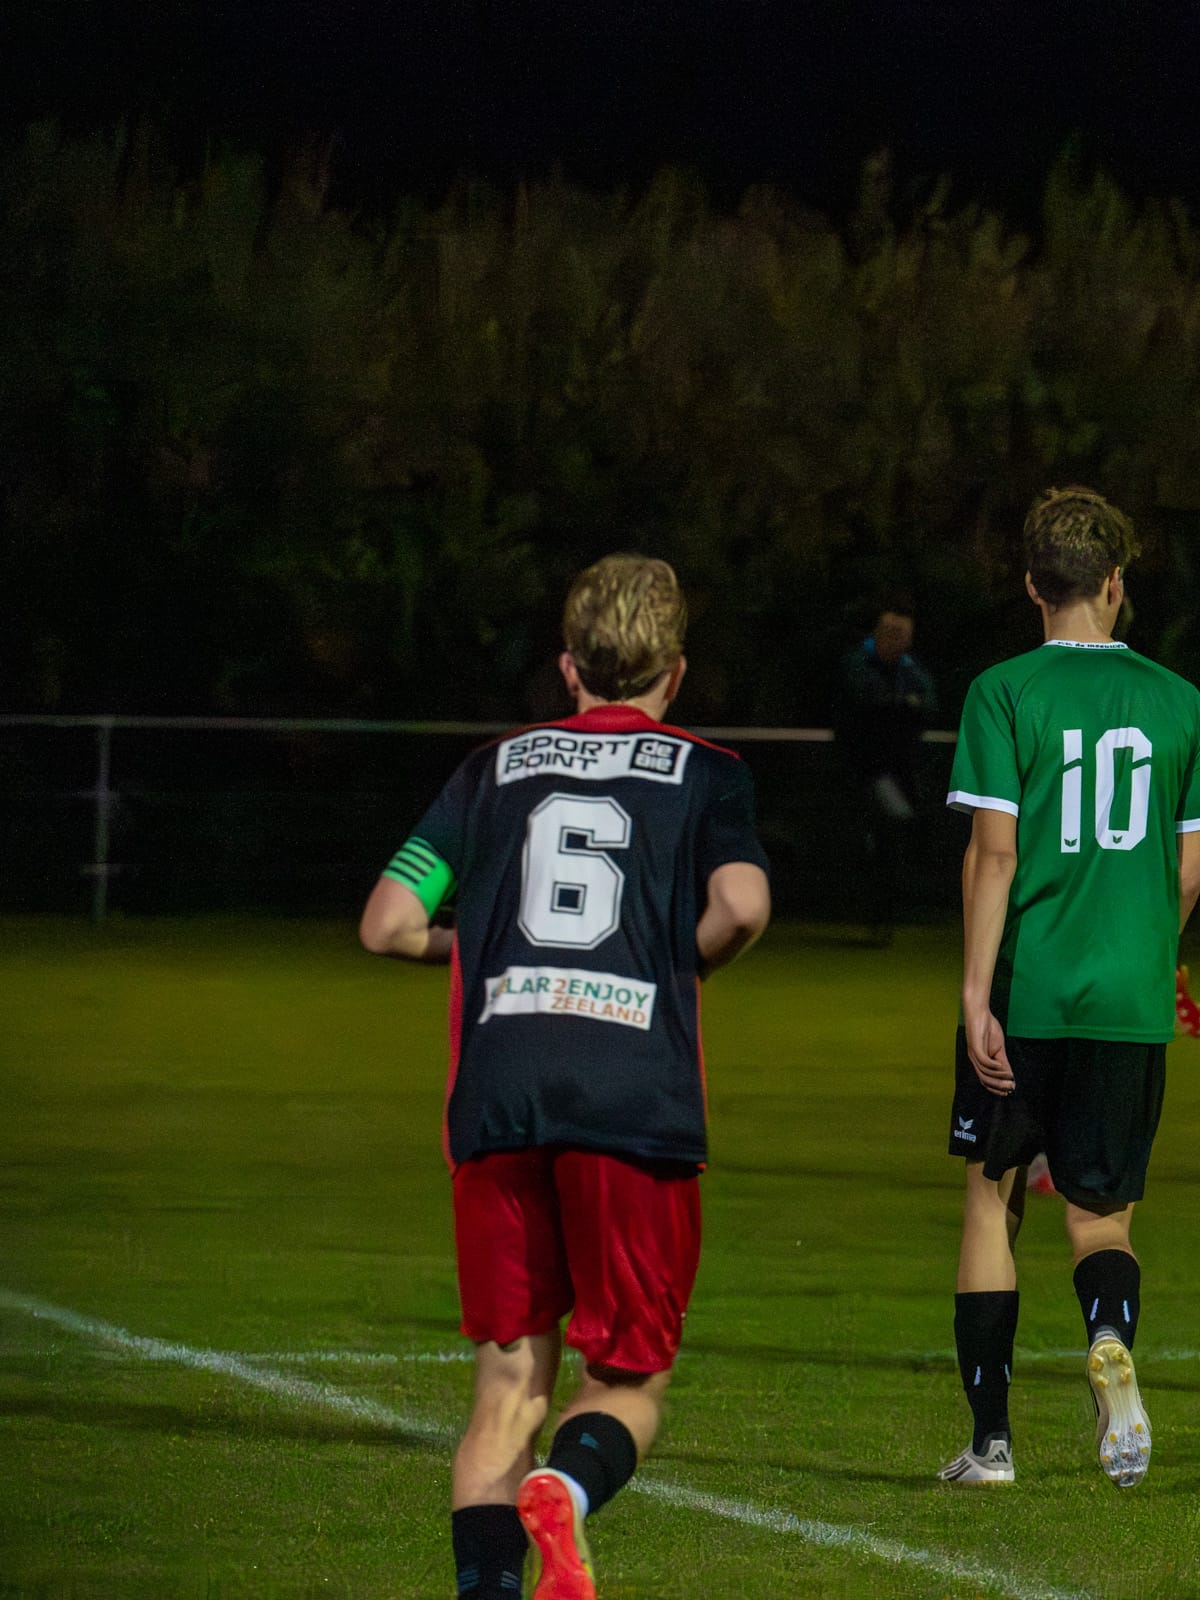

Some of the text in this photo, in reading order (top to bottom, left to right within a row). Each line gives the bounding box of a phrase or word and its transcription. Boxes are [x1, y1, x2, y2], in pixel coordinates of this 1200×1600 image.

[507, 736, 630, 758] SPORT
[640, 741, 673, 757] de
[505, 752, 598, 774] POINT
[1060, 727, 1152, 853] 10
[518, 792, 632, 950] 6
[551, 996, 647, 1025] ZEELAND
